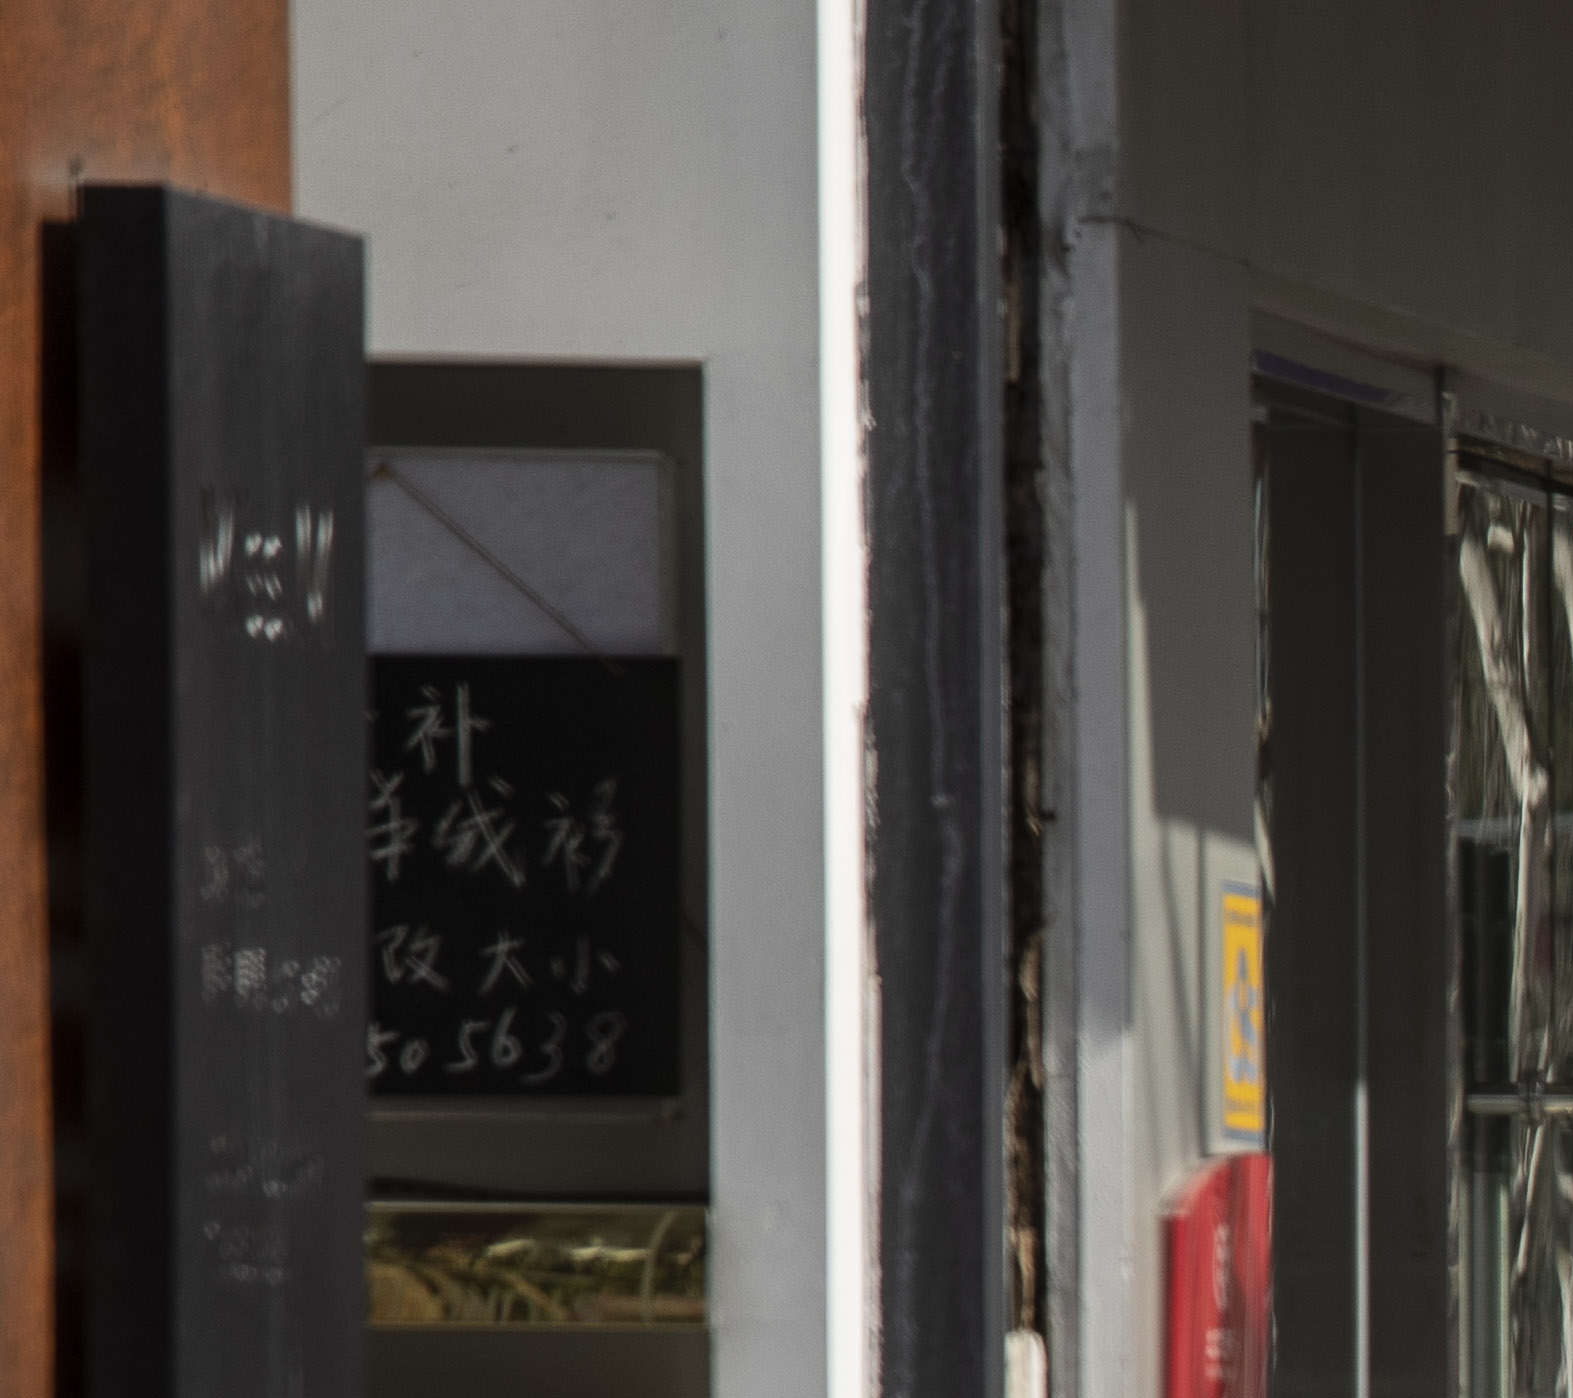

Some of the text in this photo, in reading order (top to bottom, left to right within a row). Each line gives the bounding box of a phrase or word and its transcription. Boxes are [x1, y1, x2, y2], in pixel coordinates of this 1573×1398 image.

[366, 683, 492, 787] 补
[373, 921, 624, 997] 改大小
